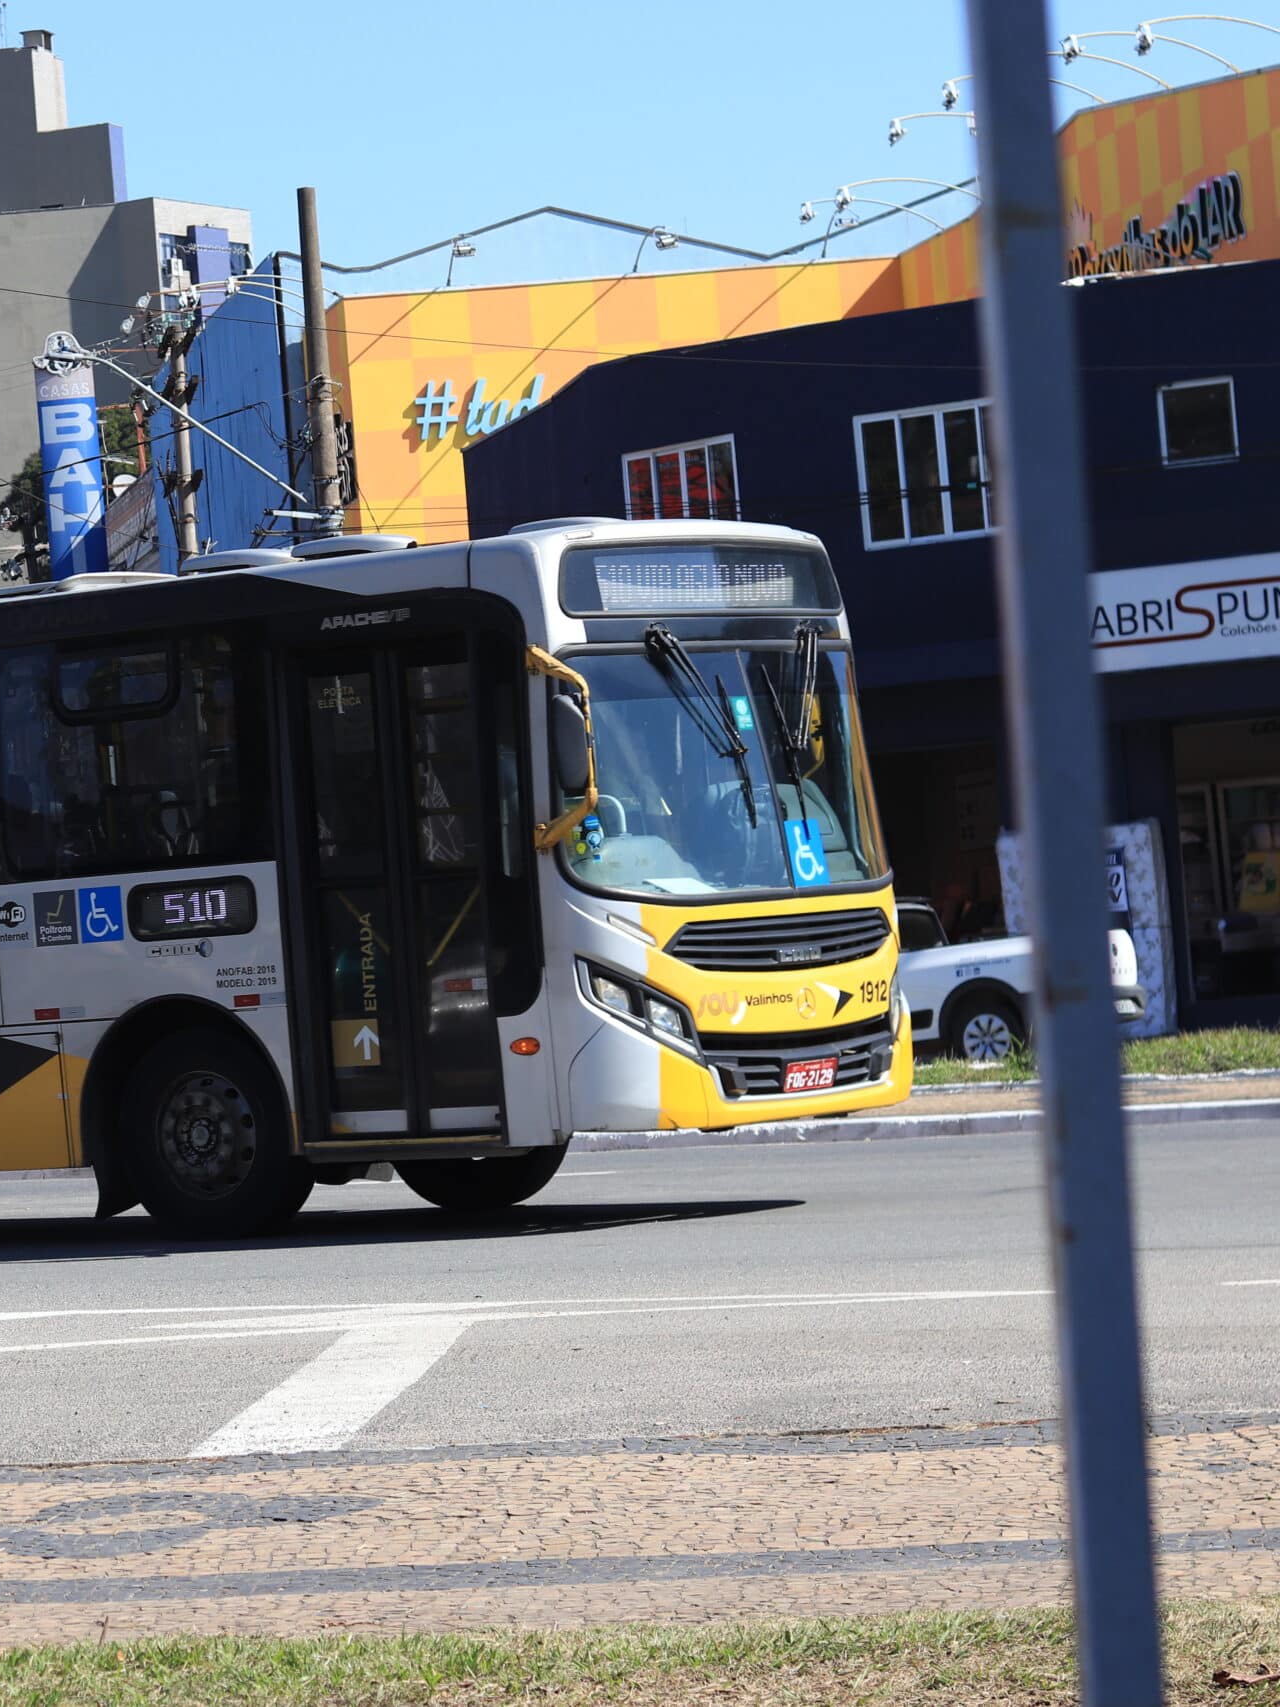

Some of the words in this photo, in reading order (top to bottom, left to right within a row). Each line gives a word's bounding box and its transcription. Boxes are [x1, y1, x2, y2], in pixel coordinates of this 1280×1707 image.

[40, 382, 90, 399] CASAS
[1221, 623, 1277, 638] Colchões
[163, 889, 227, 924] 510
[360, 911, 377, 1013] ENTRADA
[258, 977, 277, 986] 2019
[745, 991, 793, 1006] Valinhos
[860, 979, 888, 1004] 1912
